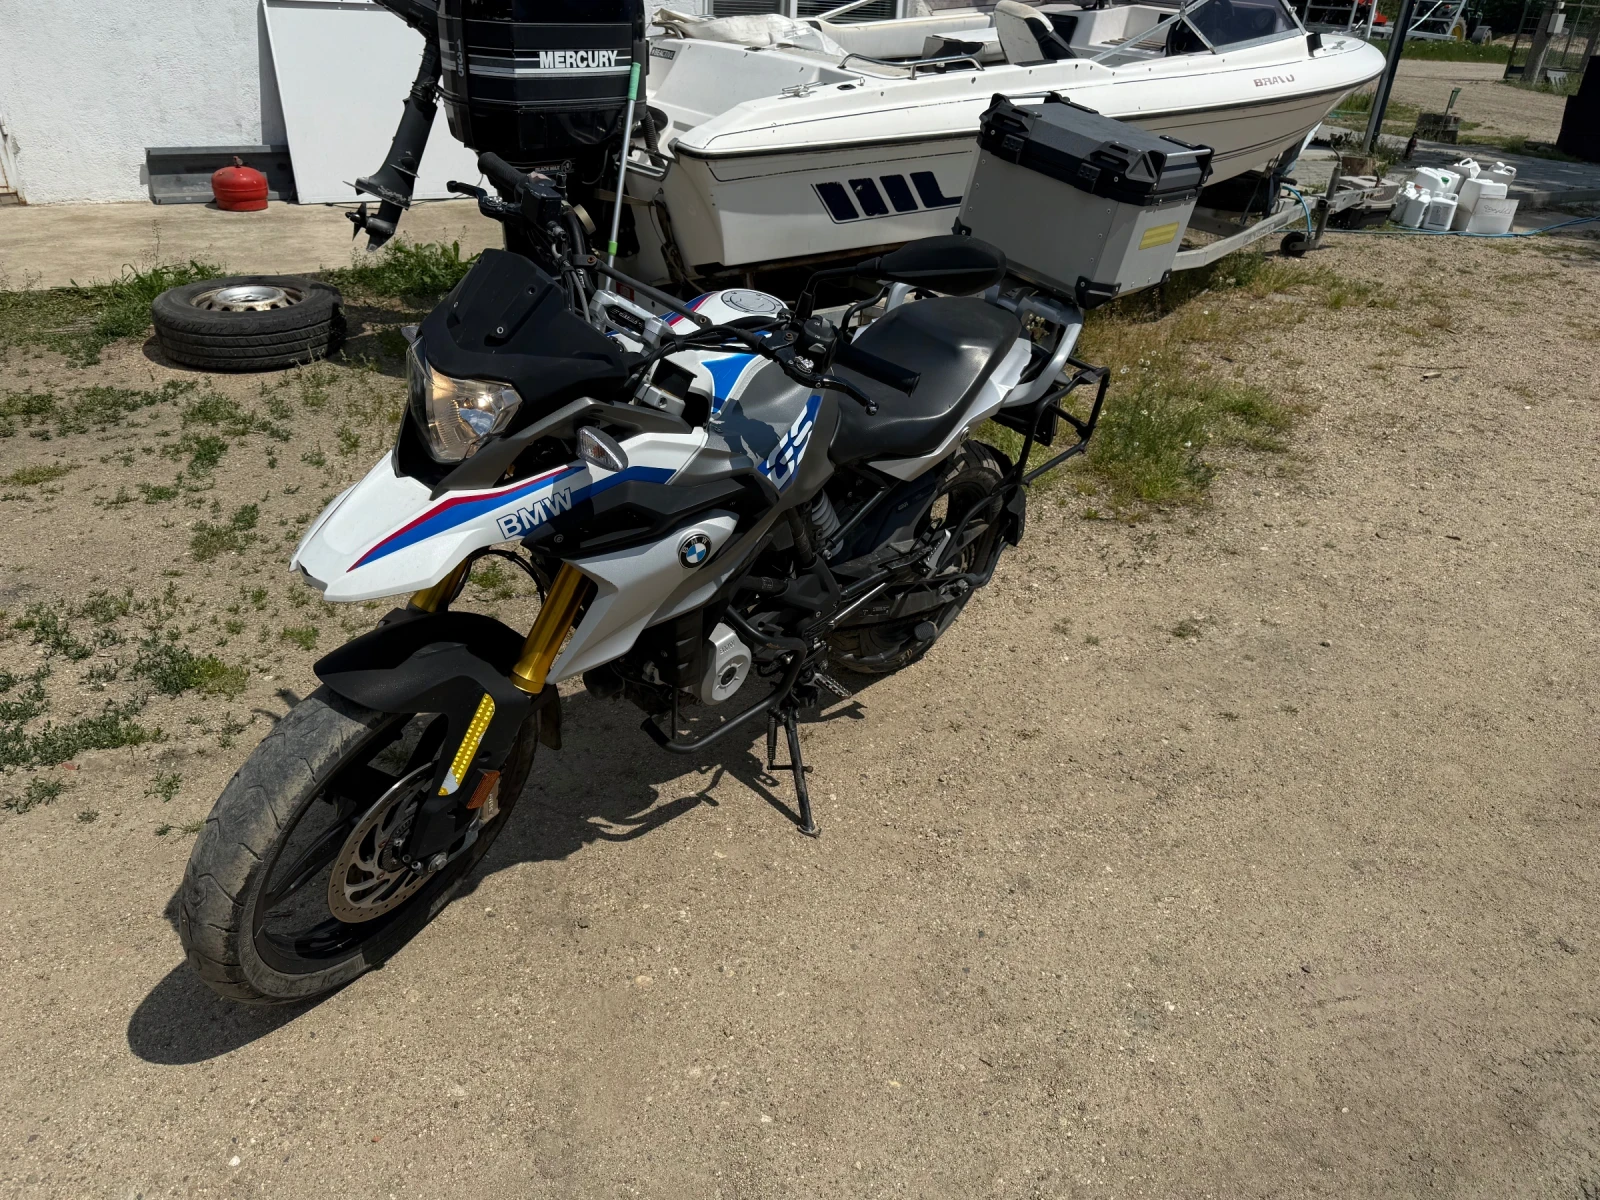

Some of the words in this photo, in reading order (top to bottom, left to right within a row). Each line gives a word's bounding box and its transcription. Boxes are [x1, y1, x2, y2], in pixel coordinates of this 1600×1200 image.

[456, 39, 465, 77] 135
[539, 50, 618, 69] MERCURY
[766, 404, 813, 490] GS
[496, 487, 572, 540] BMW
